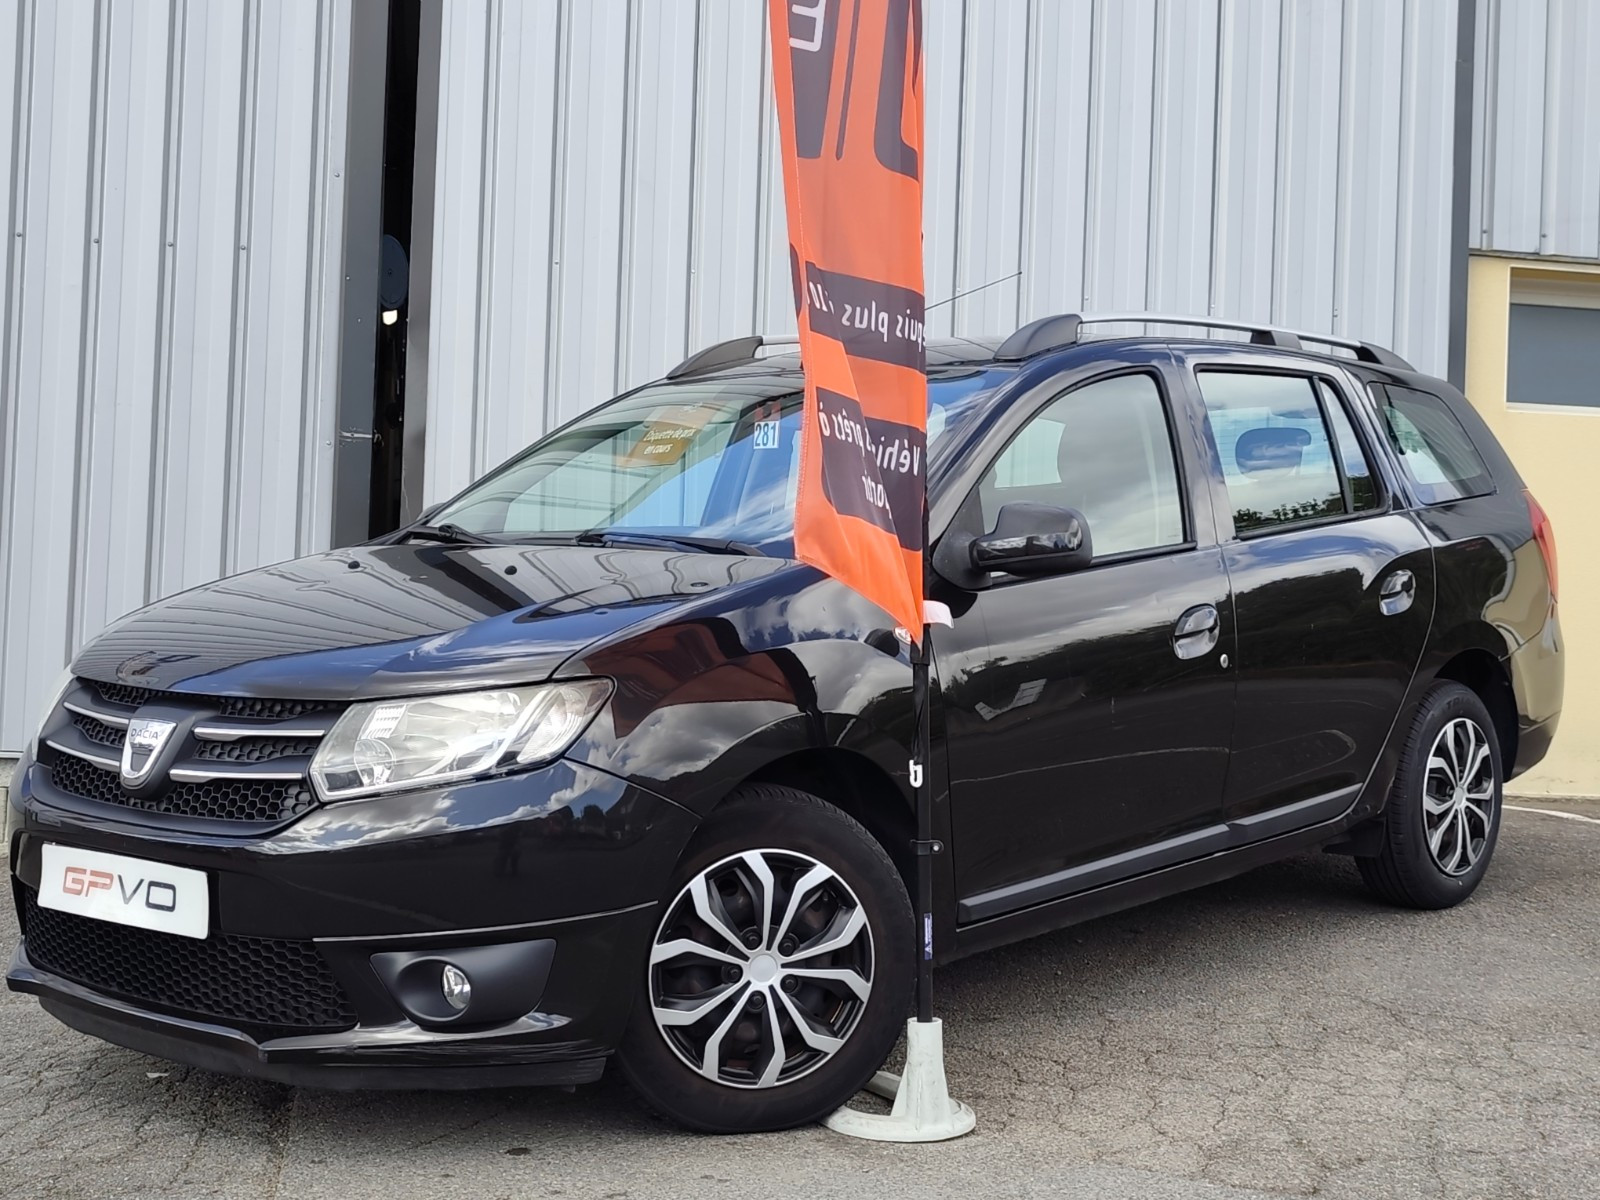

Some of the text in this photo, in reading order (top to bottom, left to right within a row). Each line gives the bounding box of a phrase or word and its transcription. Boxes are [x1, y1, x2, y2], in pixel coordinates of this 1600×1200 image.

[755, 423, 777, 446] 281
[130, 727, 160, 741] DACIA
[62, 866, 176, 913] GPVO
